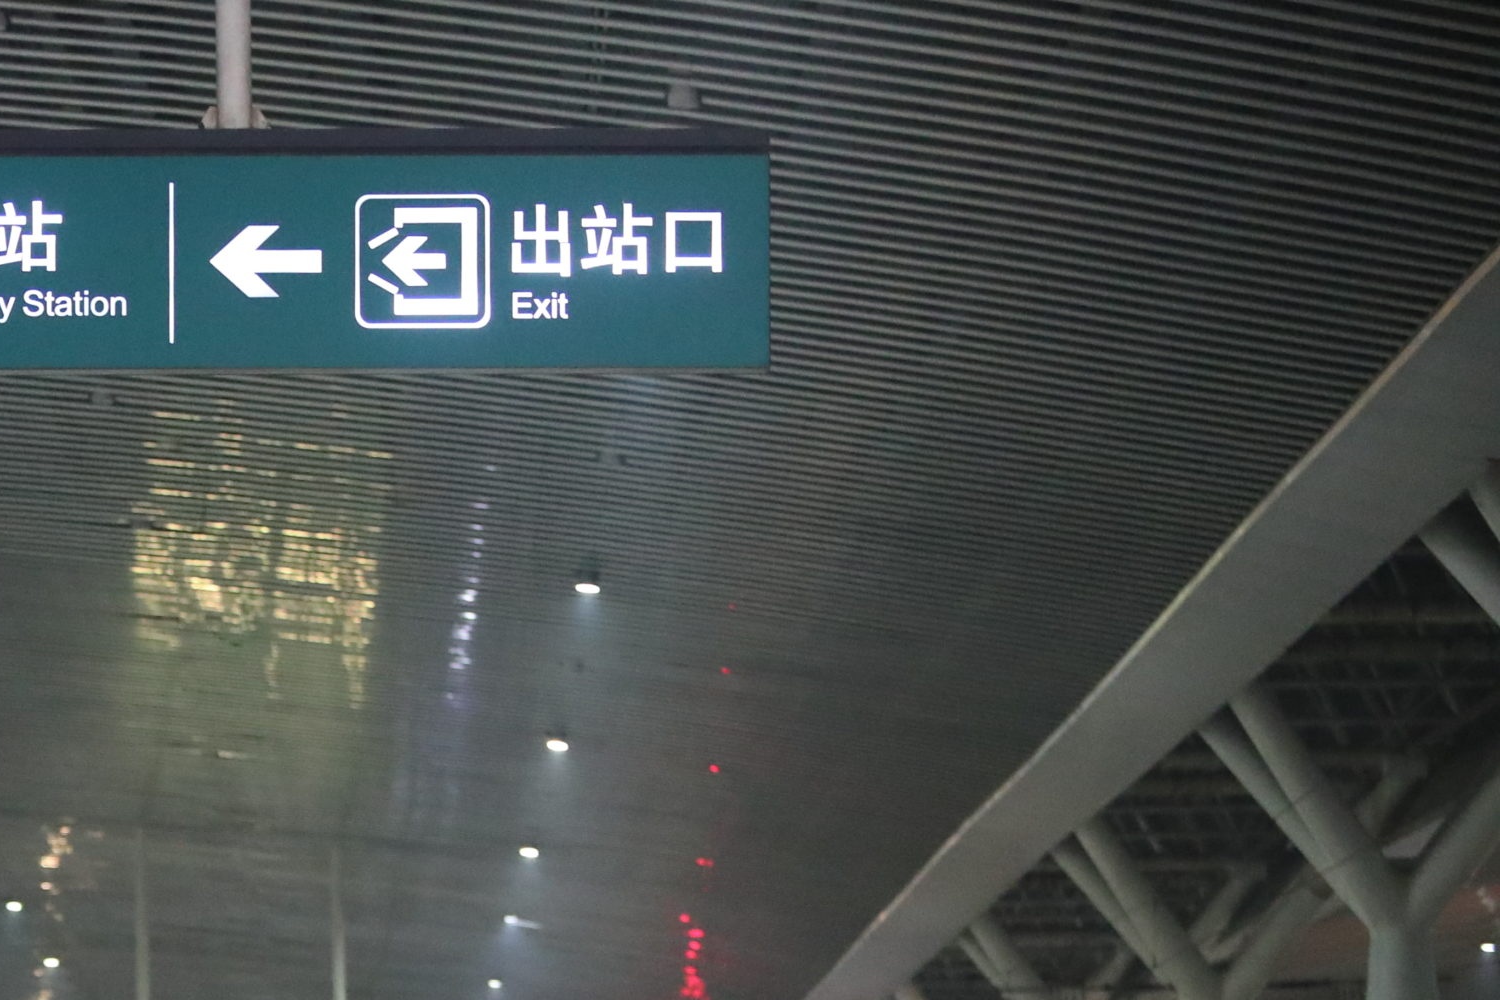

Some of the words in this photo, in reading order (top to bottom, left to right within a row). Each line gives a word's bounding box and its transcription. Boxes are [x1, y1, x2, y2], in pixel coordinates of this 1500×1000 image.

[510, 202, 723, 278] 出站口
[22, 289, 128, 317] Station
[511, 291, 569, 320] Exit
